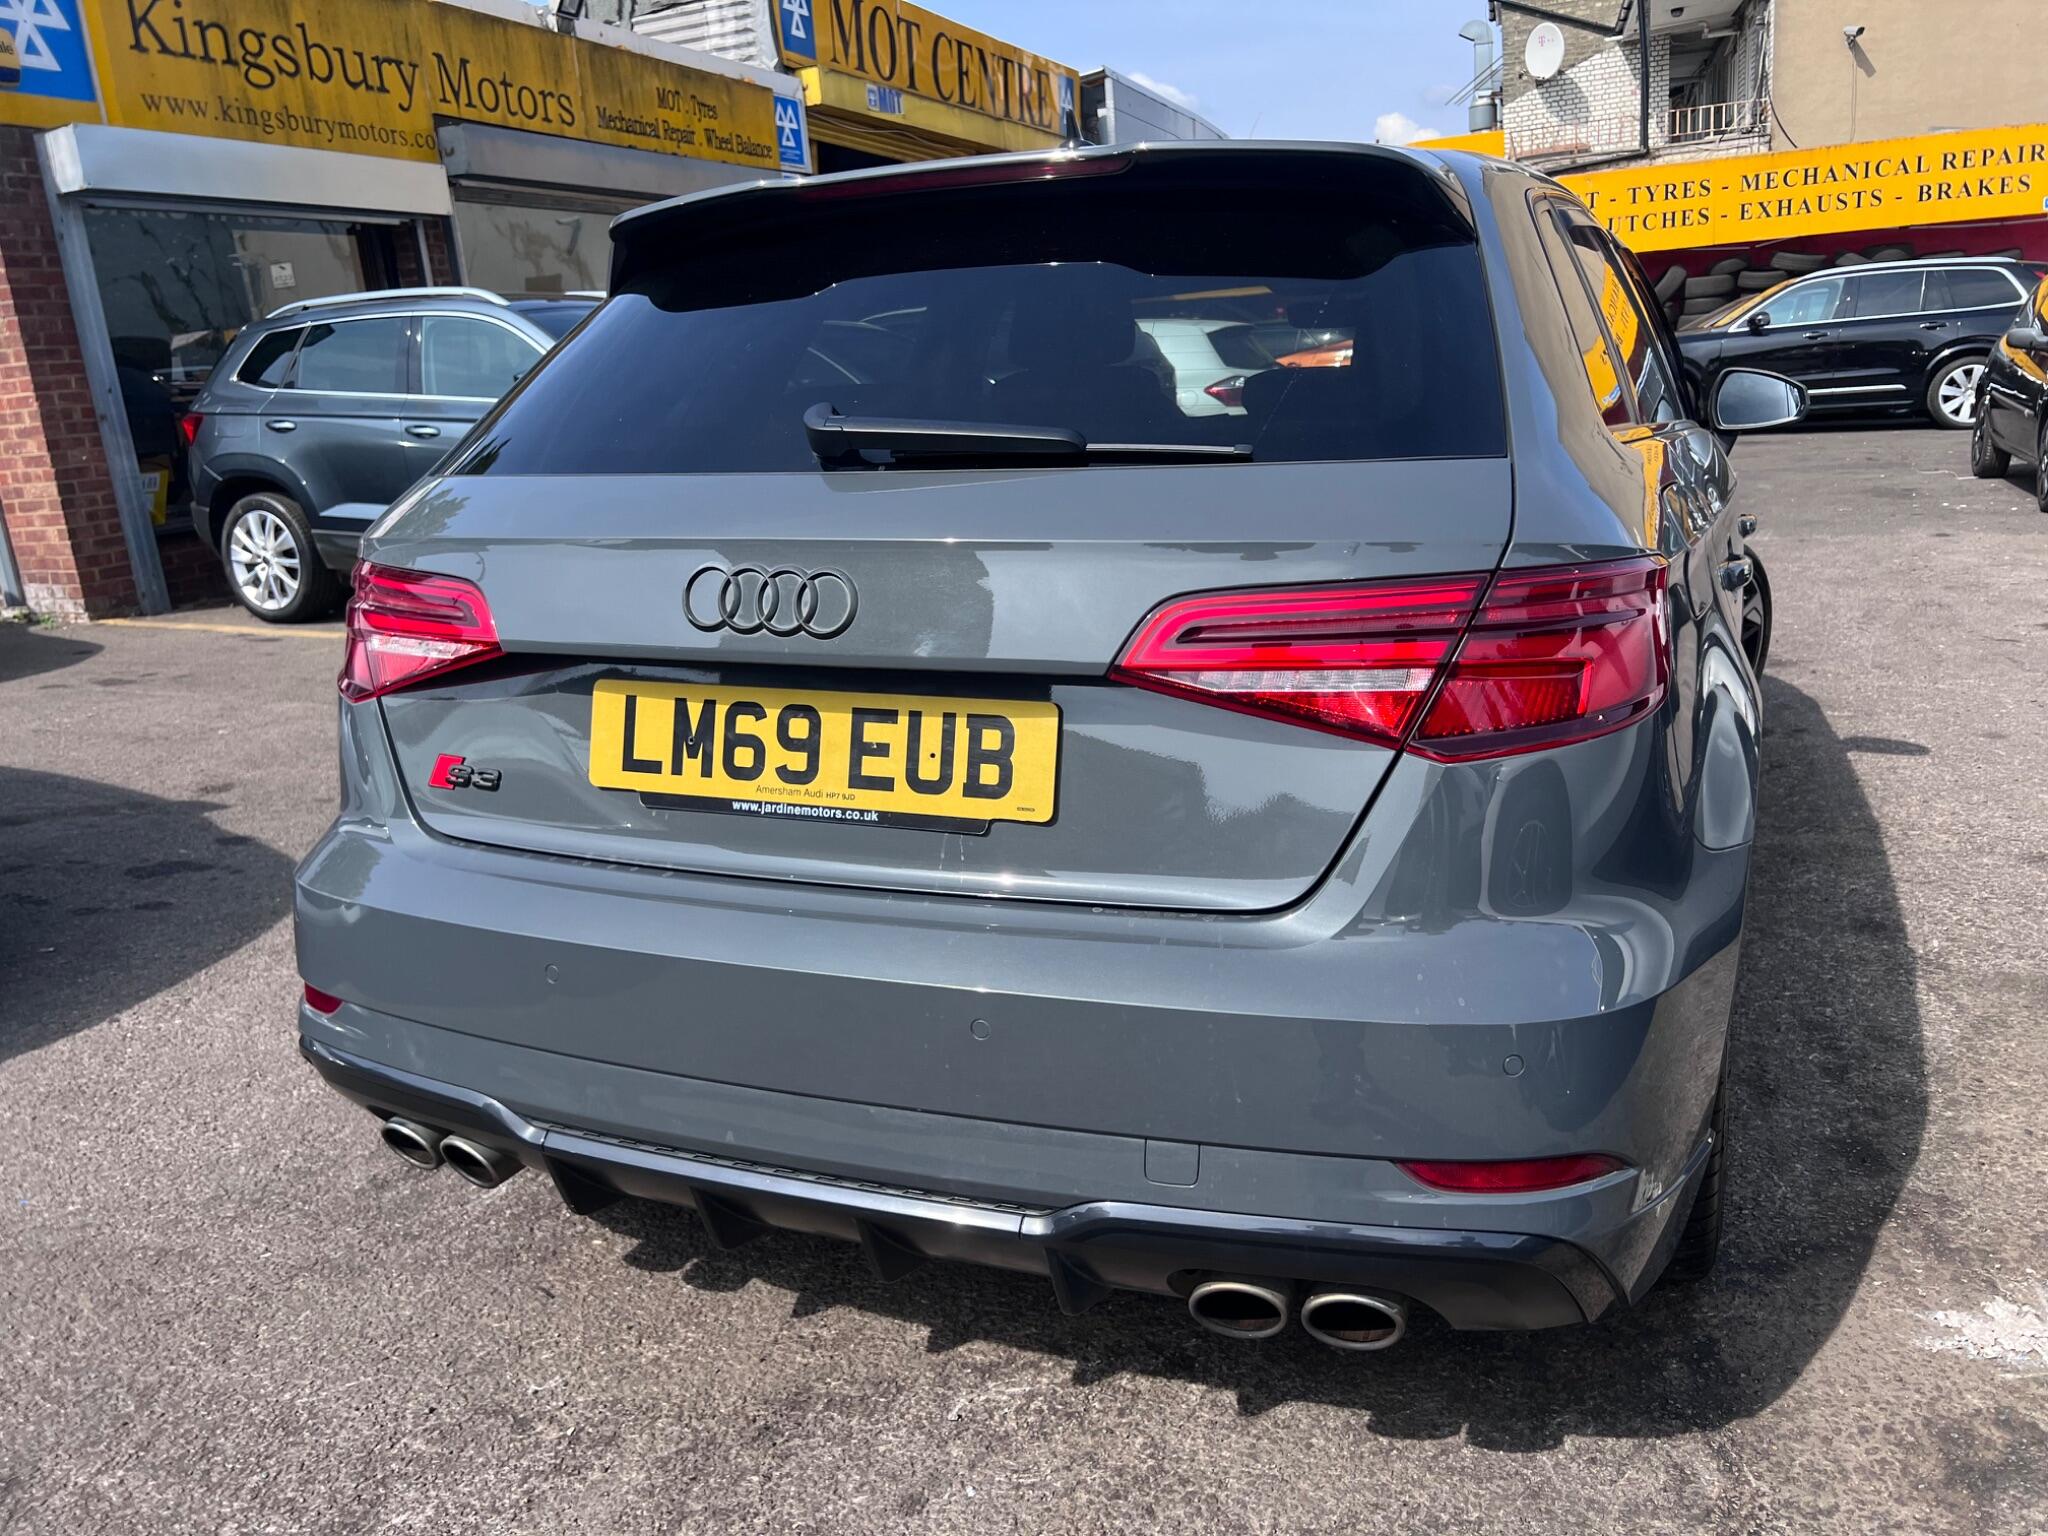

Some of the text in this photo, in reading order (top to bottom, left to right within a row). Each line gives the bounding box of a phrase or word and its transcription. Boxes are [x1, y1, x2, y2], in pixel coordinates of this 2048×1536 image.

[129, 0, 576, 127] Kingsbury Motors
[831, 0, 1053, 129] MOT CENTRE
[596, 105, 661, 139] Mechanical
[663, 119, 695, 148] Repair
[704, 128, 733, 152] Wheel
[736, 134, 773, 159] Balance
[657, 87, 680, 113] MOT
[691, 94, 718, 122] Tyres
[1608, 207, 1711, 234] UTCHES
[1738, 188, 1884, 222] EXHAUSTS
[1918, 174, 2032, 203] BRAKES
[1627, 179, 1712, 205] TYRES
[1740, 153, 1931, 192] MECHANICAL
[1941, 143, 2046, 171] REPAIR
[622, 694, 1015, 800] LM69 EUB
[732, 801, 879, 822] www.jardinemotors.co.uk
[755, 784, 802, 796] Amersham
[803, 788, 824, 798] Audi
